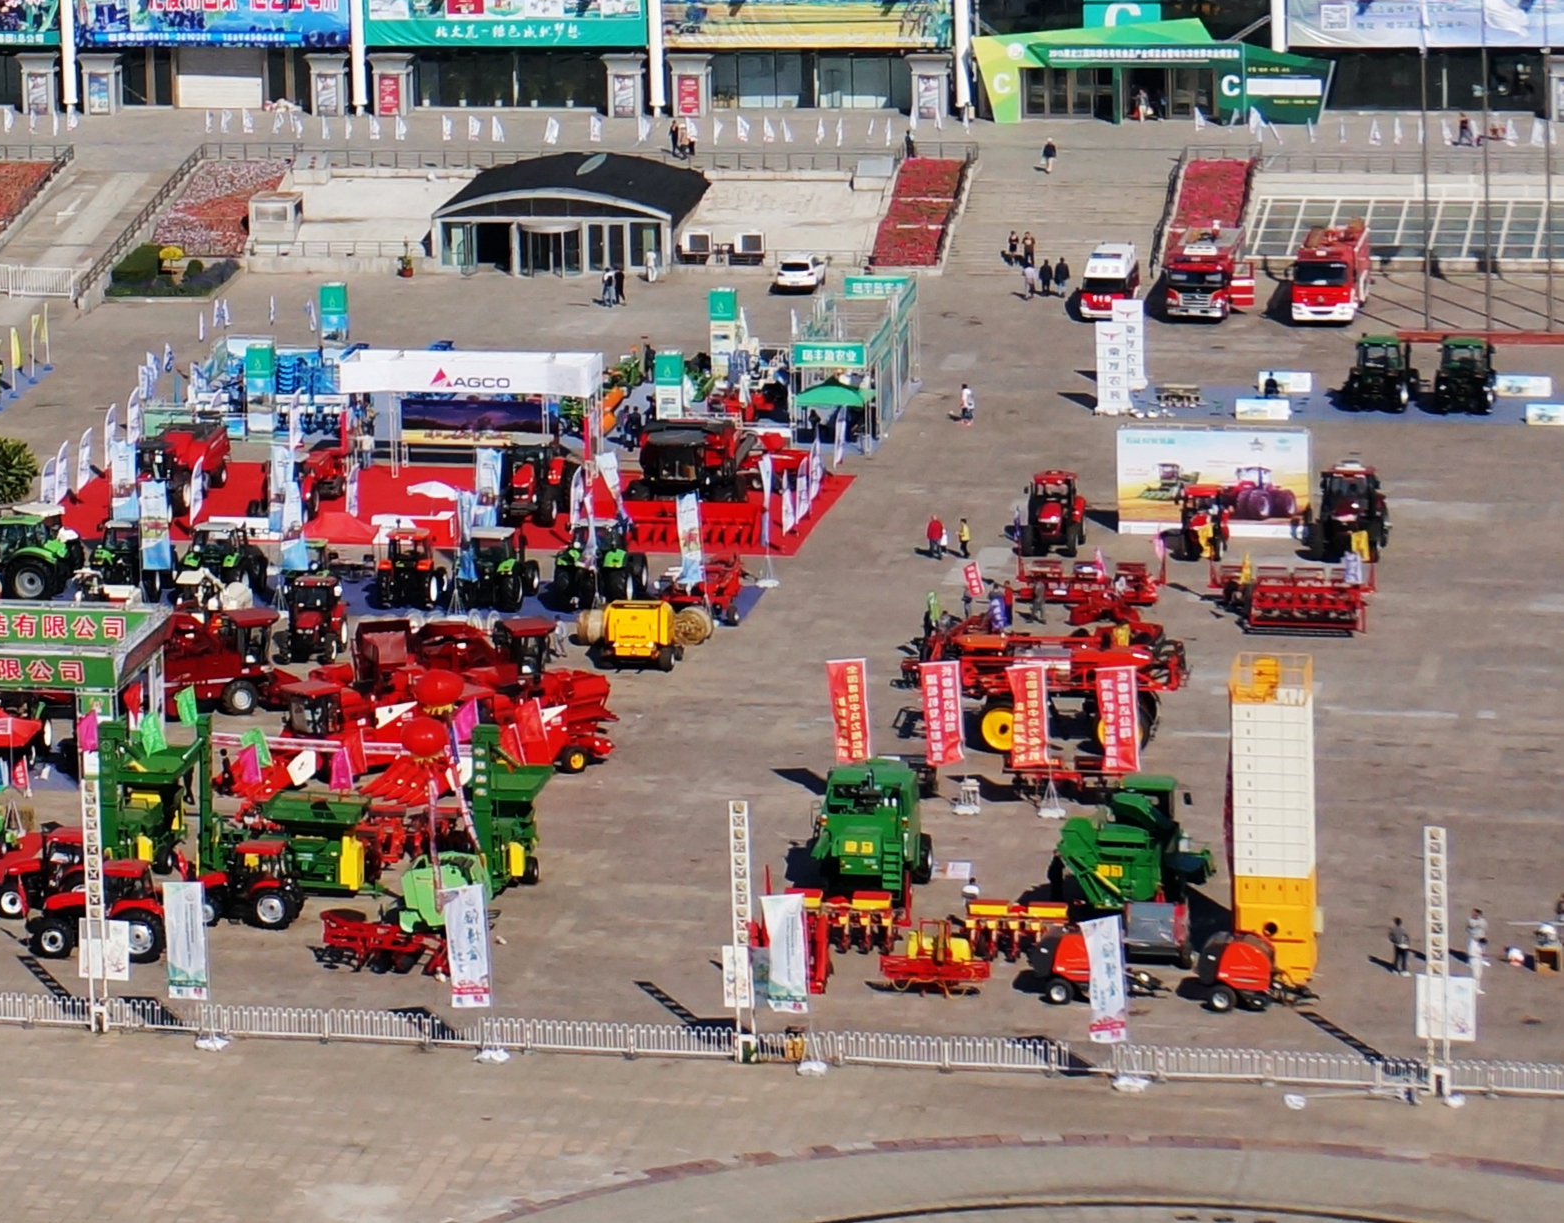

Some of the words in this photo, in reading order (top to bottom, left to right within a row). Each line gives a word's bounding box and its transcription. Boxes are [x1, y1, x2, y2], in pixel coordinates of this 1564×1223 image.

[992, 73, 1011, 94] C
[1221, 75, 1240, 96] C
[454, 377, 510, 389] AGCO
